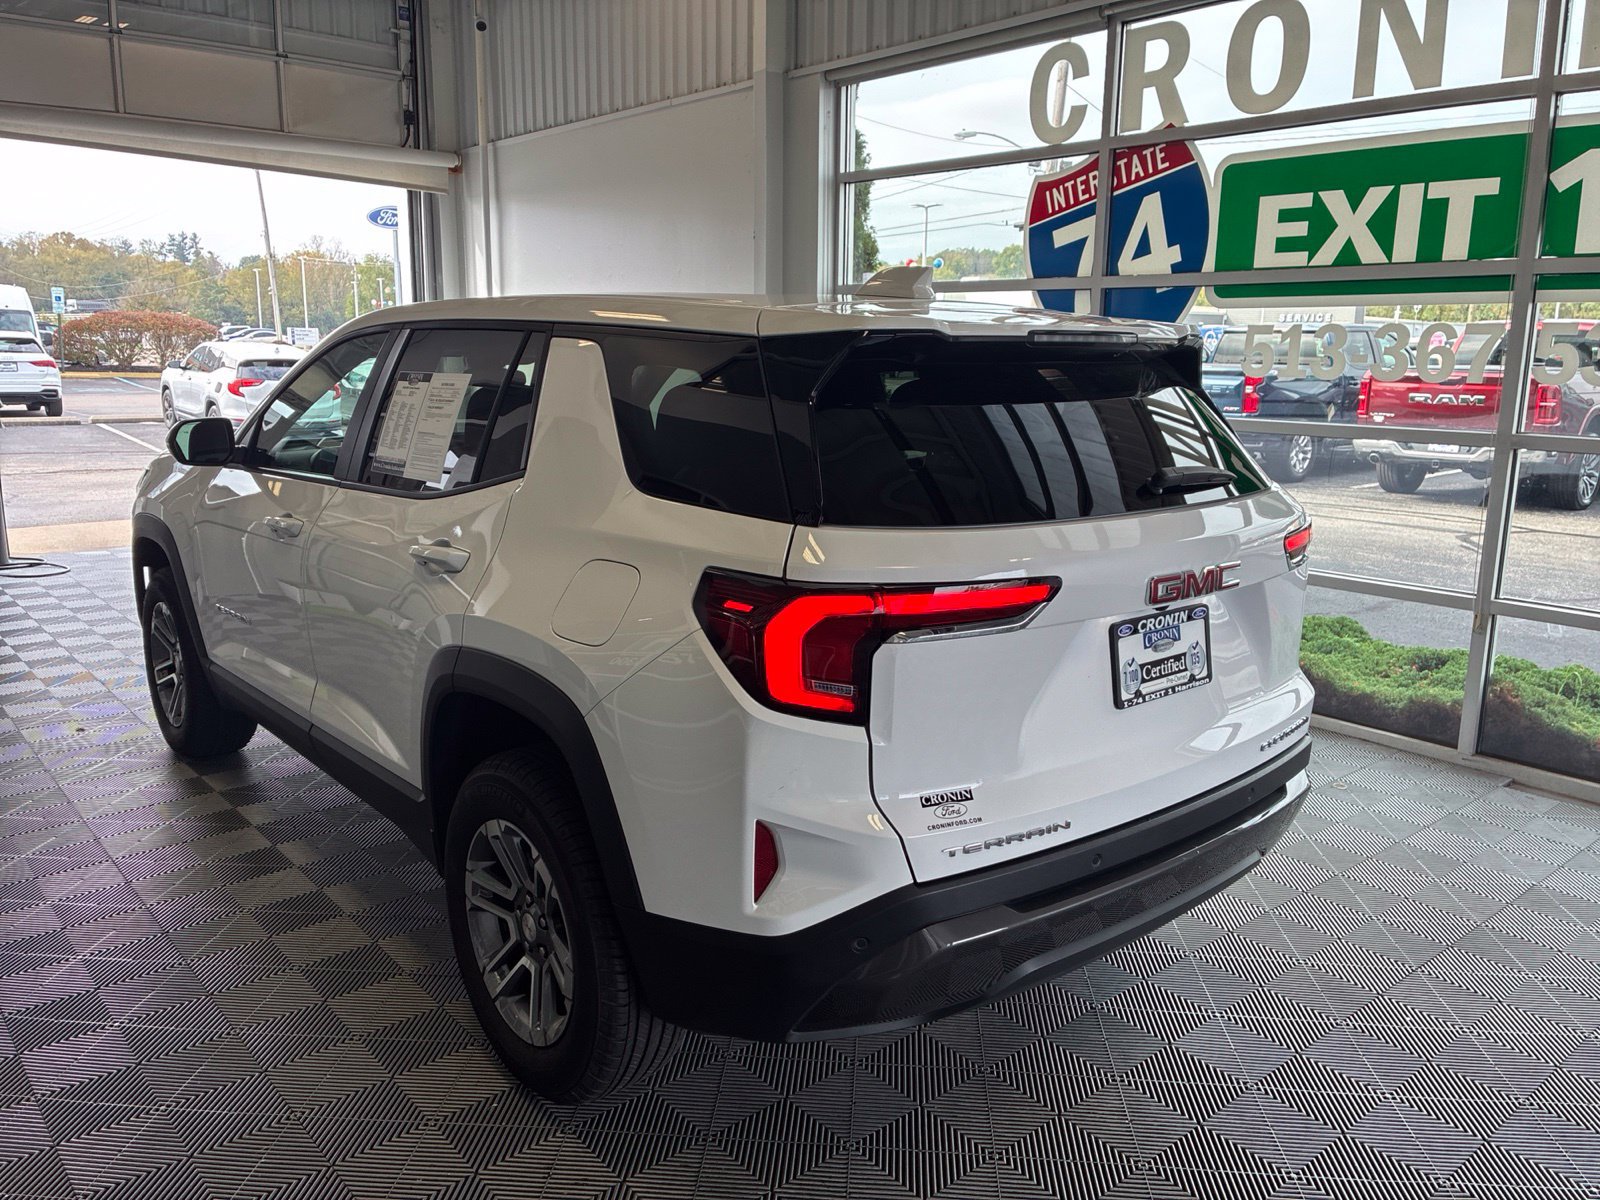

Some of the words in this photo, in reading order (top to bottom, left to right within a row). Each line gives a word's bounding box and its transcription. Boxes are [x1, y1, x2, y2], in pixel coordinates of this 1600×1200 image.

[1029, 0, 1600, 144] CRONI
[1045, 144, 1169, 213] INTERTATE
[1254, 177, 1500, 268] EXIT
[1053, 191, 1182, 313] 74
[1279, 313, 1333, 323] SERVICE
[1409, 393, 1486, 406] RAM
[1145, 560, 1241, 606] GMC
[1138, 610, 1188, 632] CRONIN
[1145, 626, 1179, 647] CRONIN
[1143, 656, 1186, 679] Certified
[1124, 697, 1143, 708] I-74
[1145, 690, 1166, 702] EXIT
[1175, 678, 1210, 692] Harrison
[922, 788, 972, 806] CRONIN
[941, 805, 962, 817] Ford
[927, 816, 983, 831] CRONINFORD.COM
[941, 819, 1072, 857] TERRAIN
